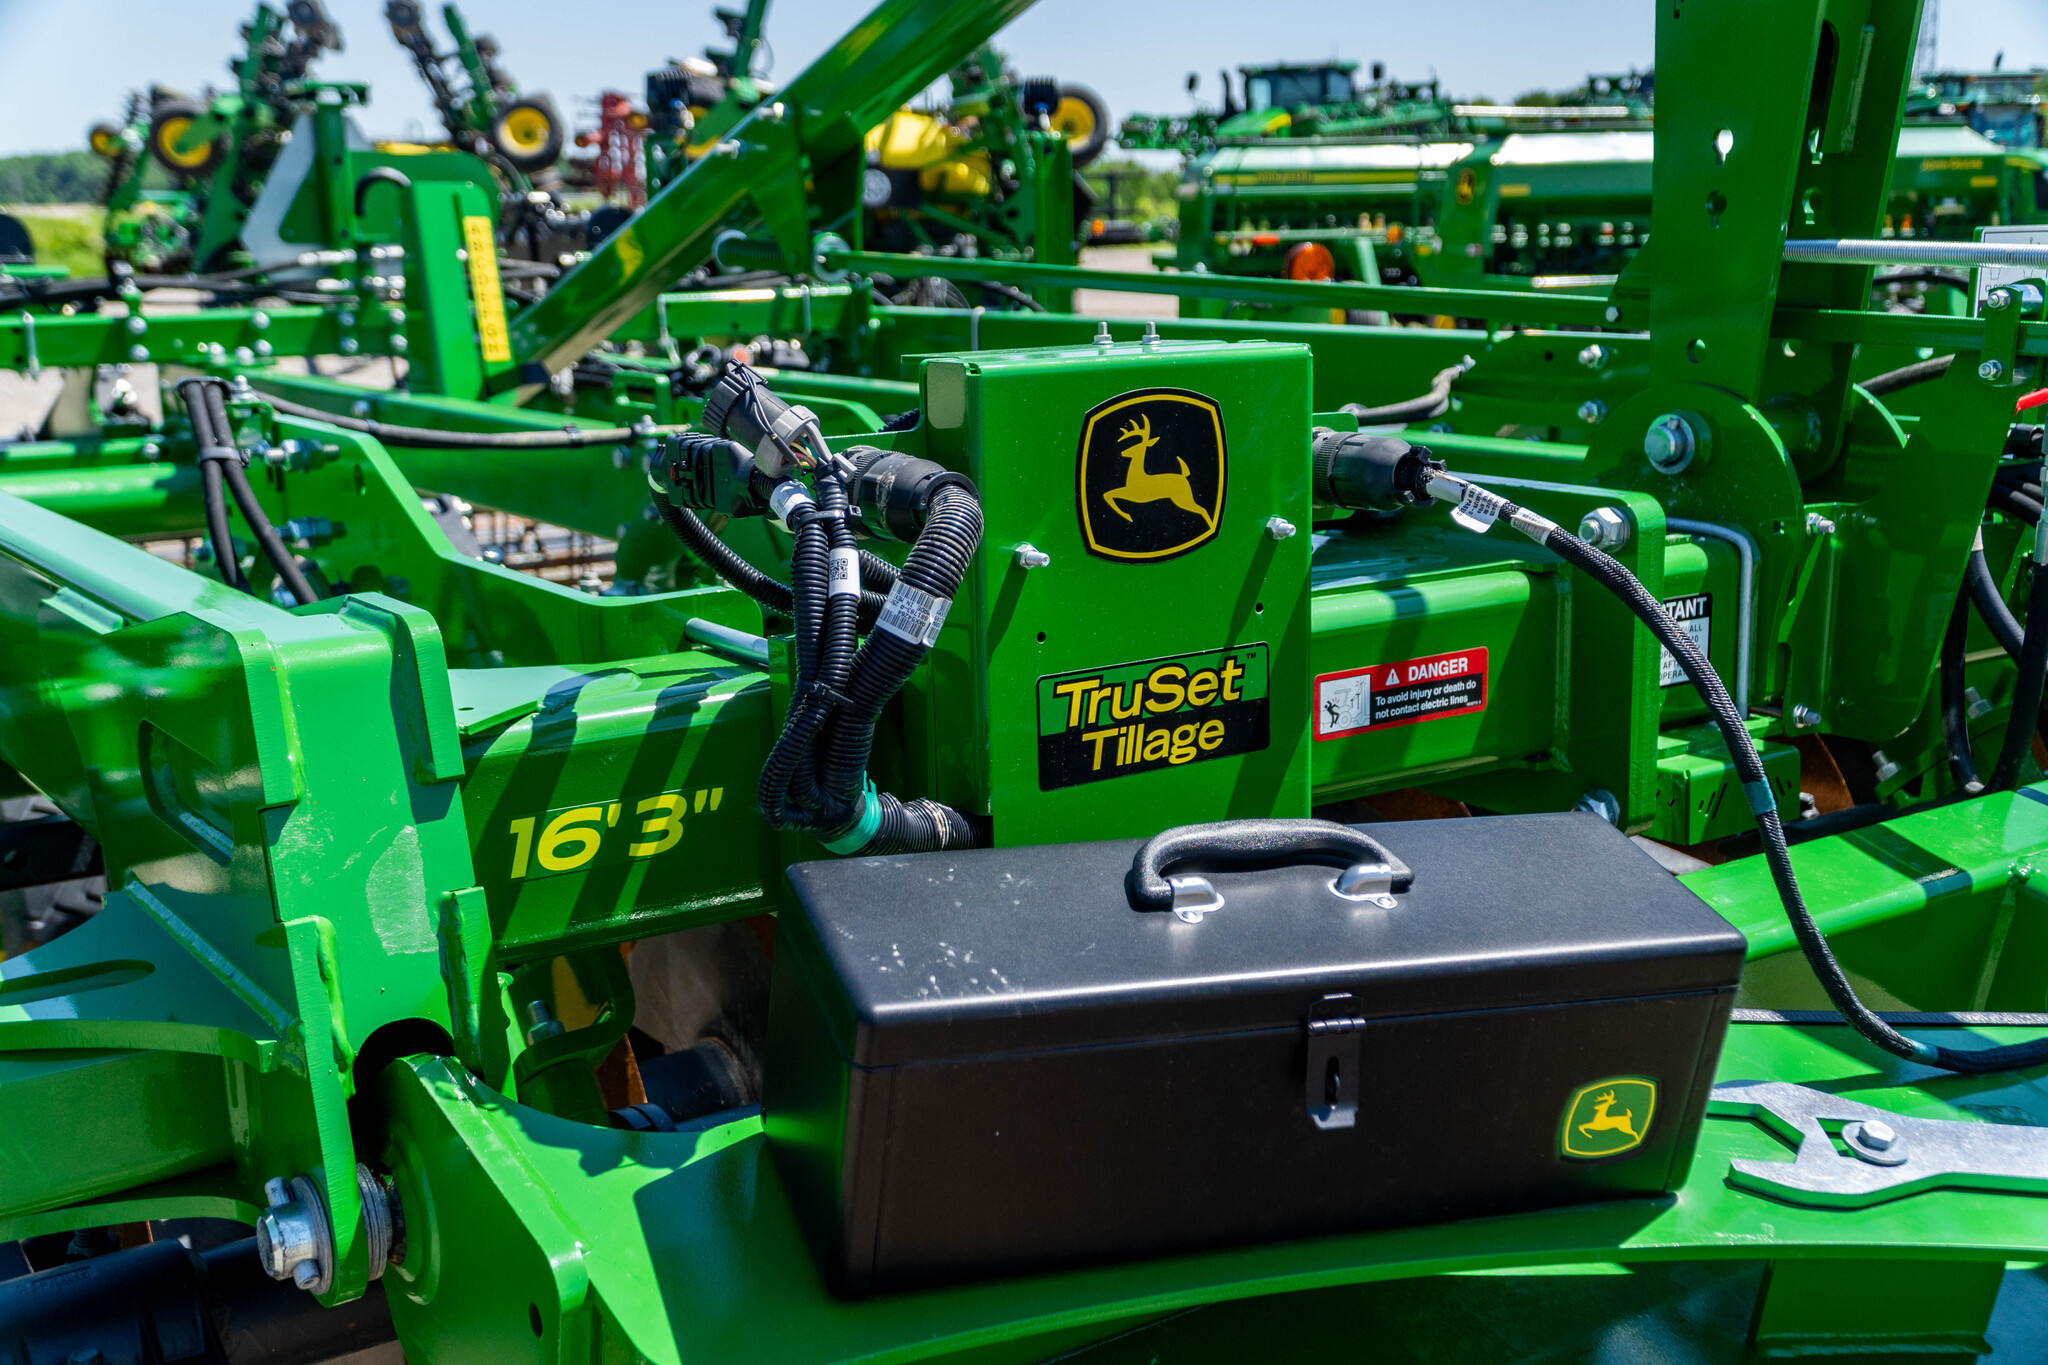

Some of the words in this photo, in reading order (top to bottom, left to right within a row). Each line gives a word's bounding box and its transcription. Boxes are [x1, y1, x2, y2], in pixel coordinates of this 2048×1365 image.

[1661, 597, 1707, 620] TANT
[1689, 623, 1703, 633] ALL
[1408, 657, 1469, 682] DANGER
[1056, 659, 1243, 728] TruSet
[1375, 696, 1386, 706] To
[1387, 691, 1409, 704] avoid
[1410, 688, 1433, 701] injury
[1433, 686, 1443, 696] or
[1443, 681, 1465, 694] death
[1466, 679, 1477, 690] do
[1375, 708, 1389, 719] not
[1390, 703, 1420, 717] contact
[1420, 697, 1449, 711] electric
[1450, 694, 1469, 706] lines
[1082, 719, 1225, 771] Tillage
